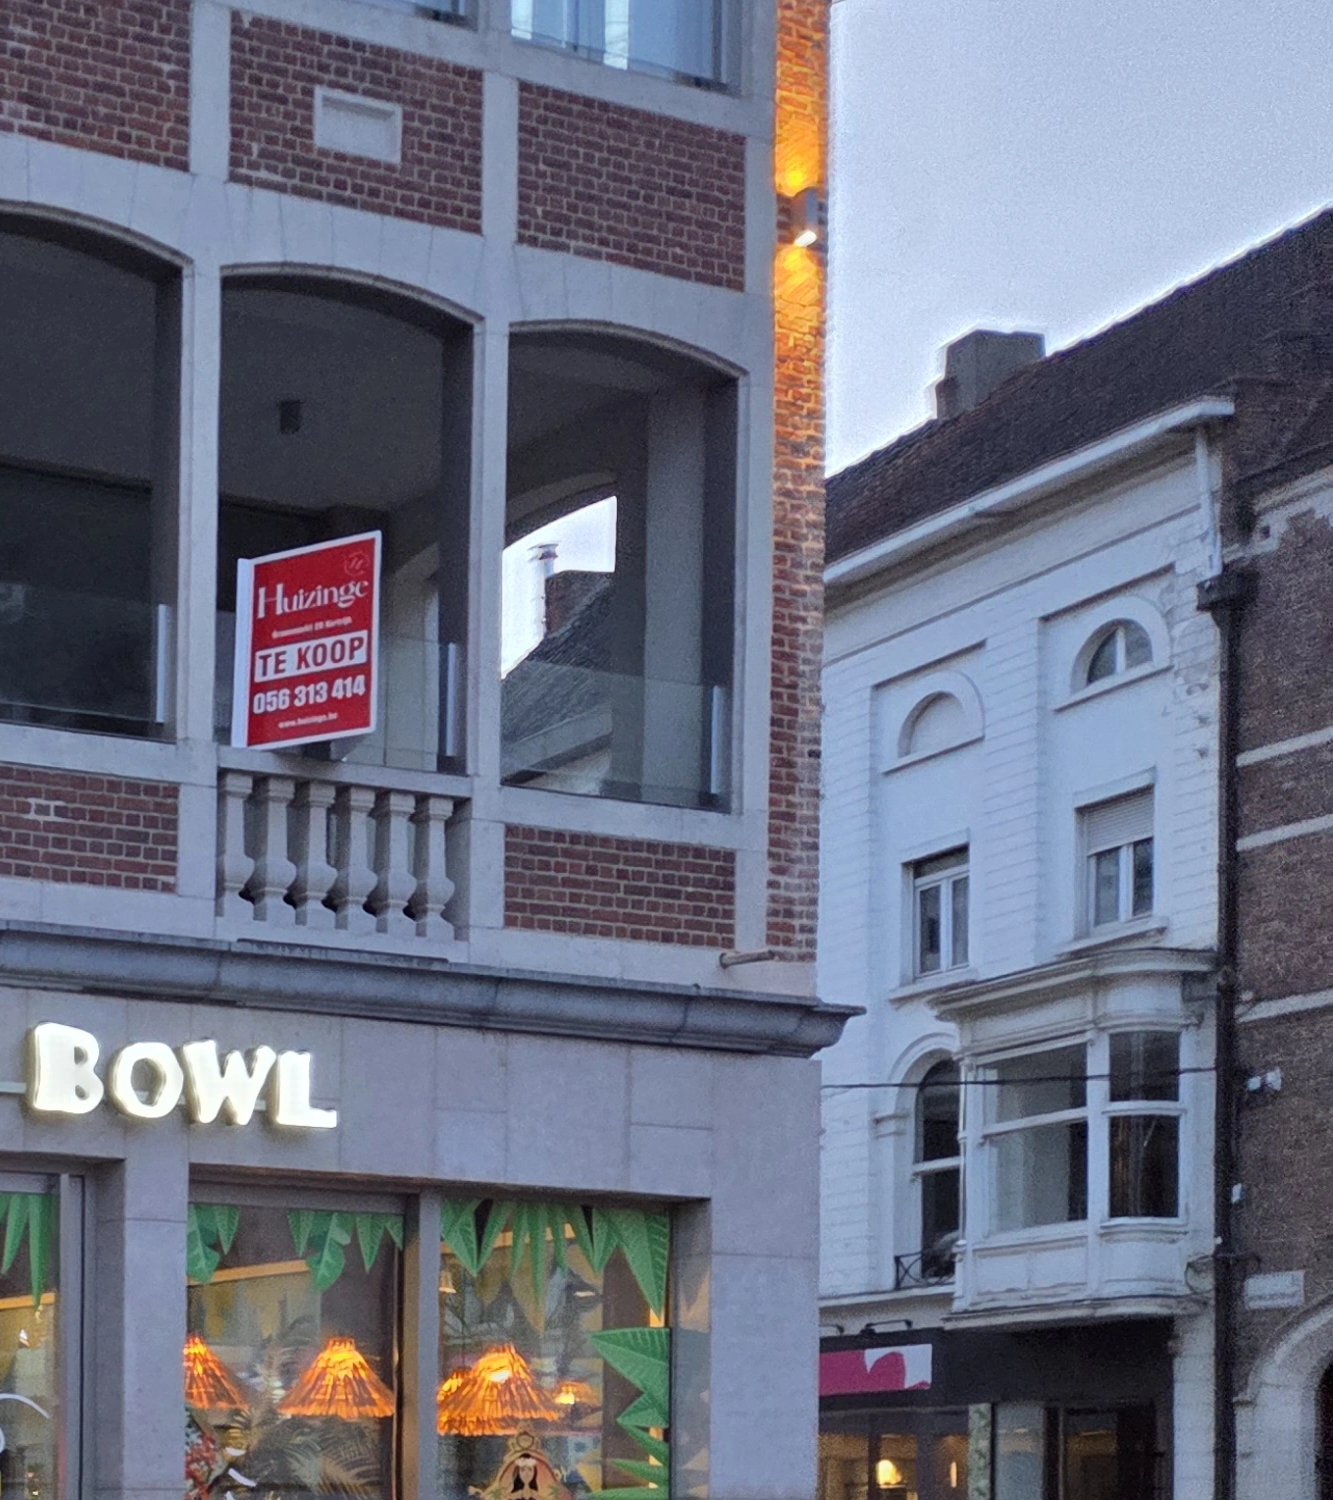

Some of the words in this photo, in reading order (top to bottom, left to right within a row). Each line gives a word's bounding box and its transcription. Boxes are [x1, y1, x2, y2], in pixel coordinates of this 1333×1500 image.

[257, 579, 369, 619] Huizinge
[258, 651, 287, 677] TE
[296, 636, 365, 671] KOOP
[253, 688, 290, 715] 056
[293, 681, 328, 707] 313
[331, 674, 366, 700] 414
[28, 1020, 339, 1129] BOWL
